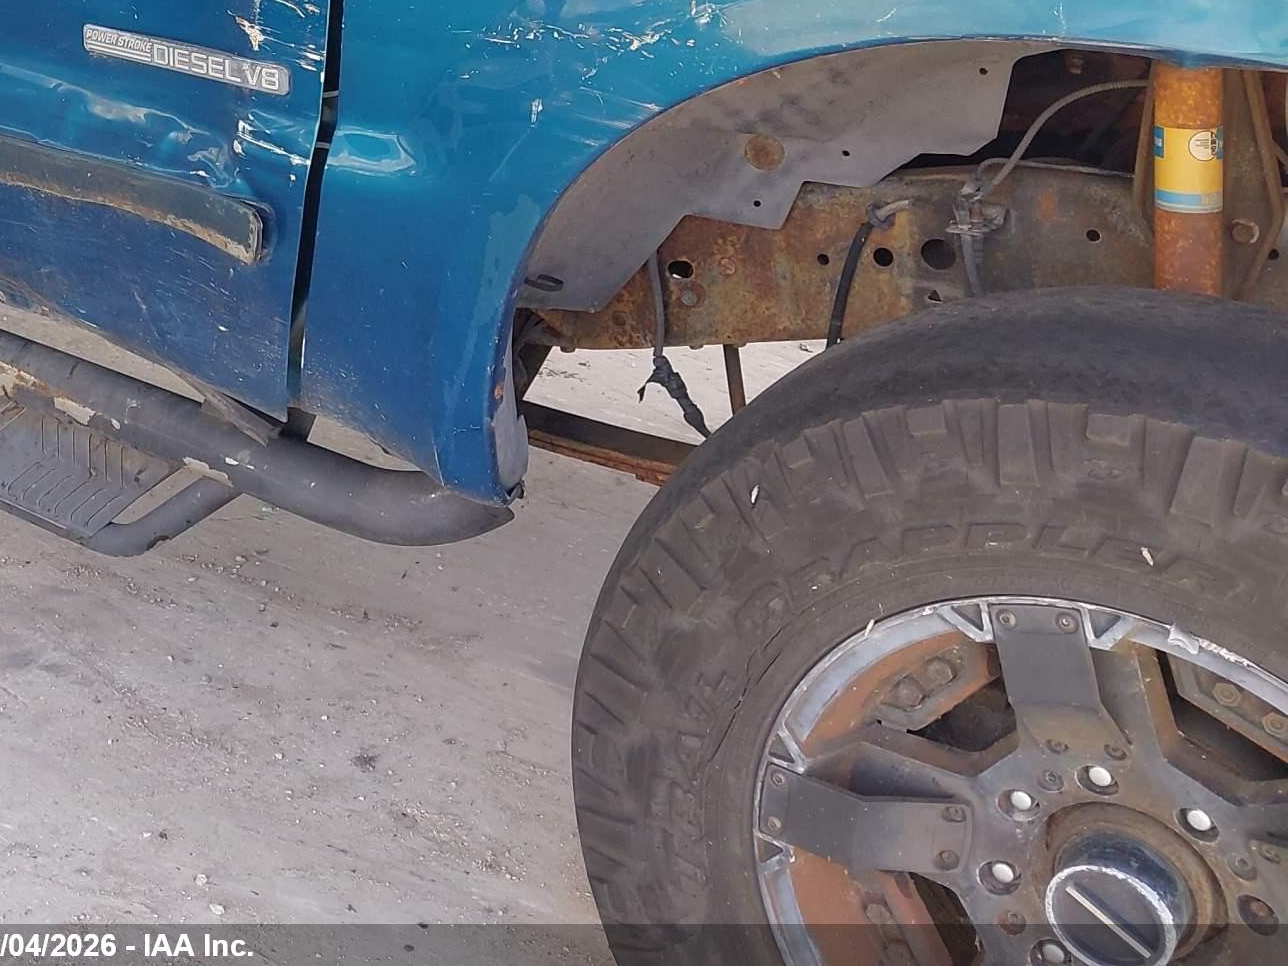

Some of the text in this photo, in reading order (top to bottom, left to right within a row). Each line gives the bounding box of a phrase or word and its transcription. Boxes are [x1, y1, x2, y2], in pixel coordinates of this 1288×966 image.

[86, 28, 280, 91] POWER STROKE DIESEL V8
